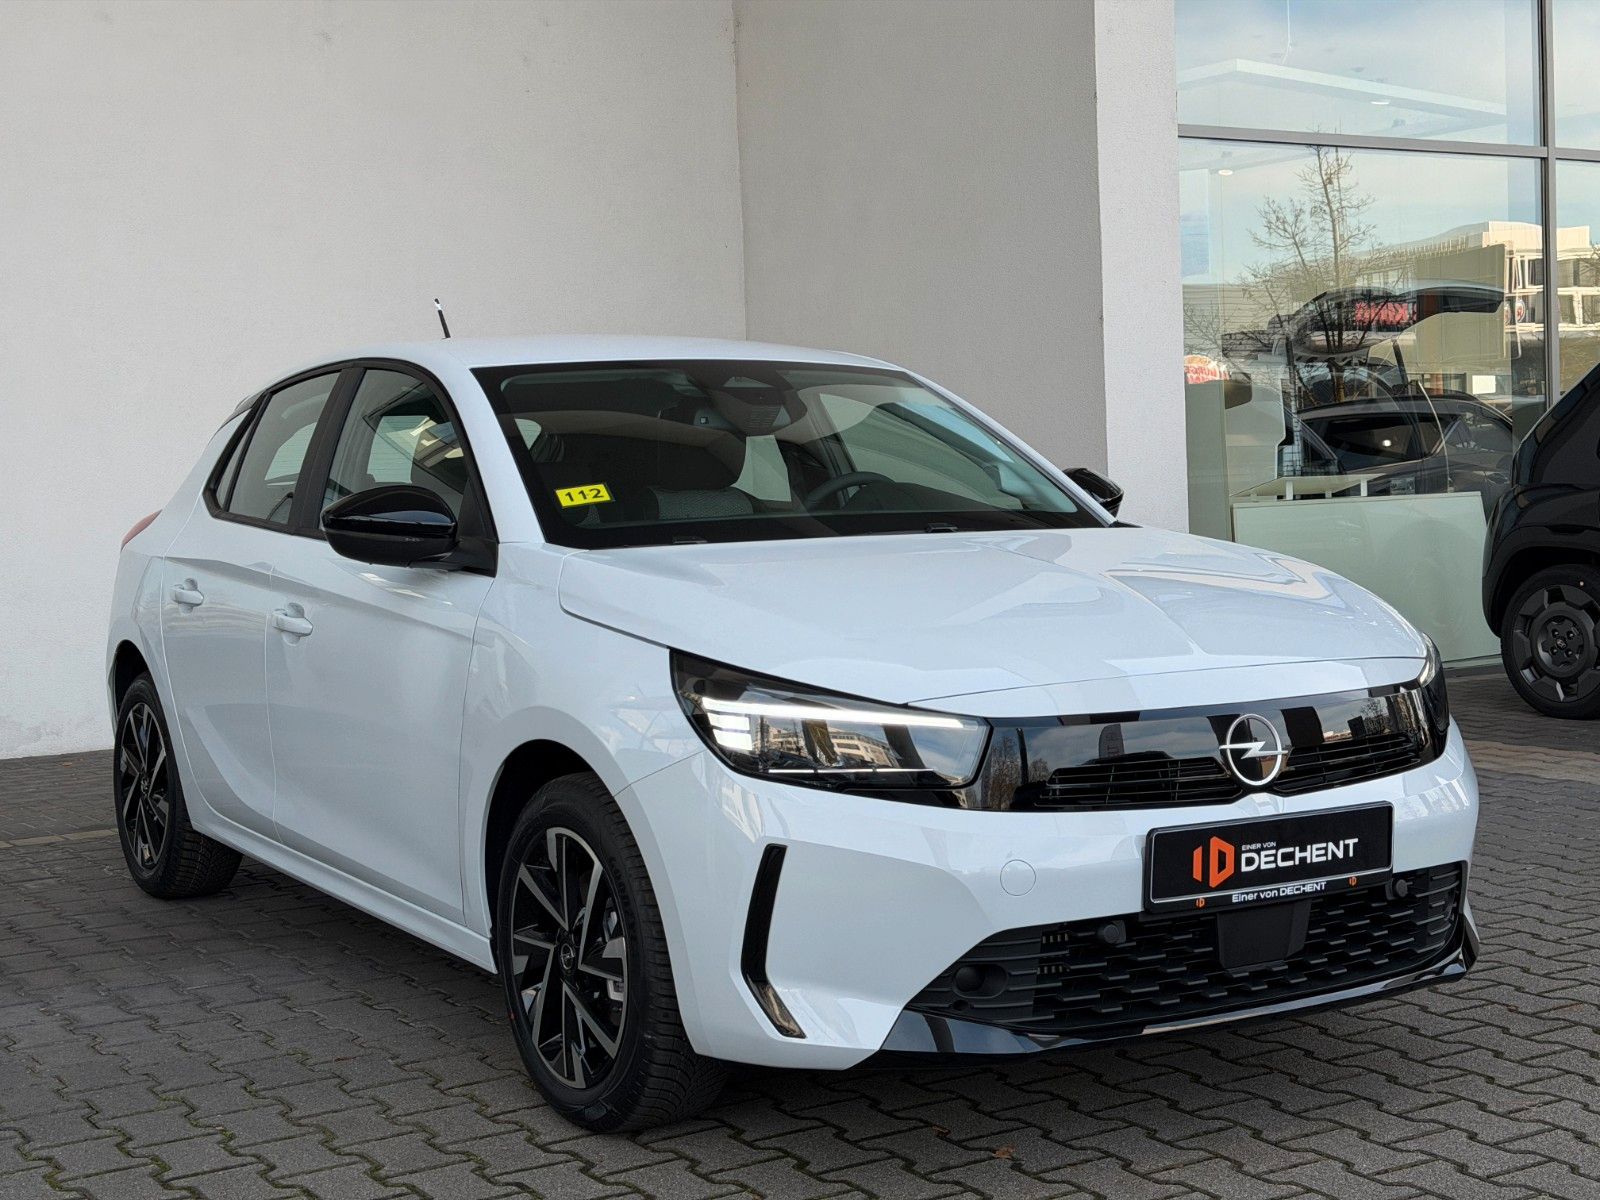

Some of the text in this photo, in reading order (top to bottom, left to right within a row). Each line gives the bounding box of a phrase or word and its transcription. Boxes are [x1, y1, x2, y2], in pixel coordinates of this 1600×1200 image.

[565, 487, 604, 502] 112
[1240, 838, 1359, 873] DECHENT
[1241, 843, 1262, 851] EINER
[1231, 881, 1327, 903] Einer von DECHENT
